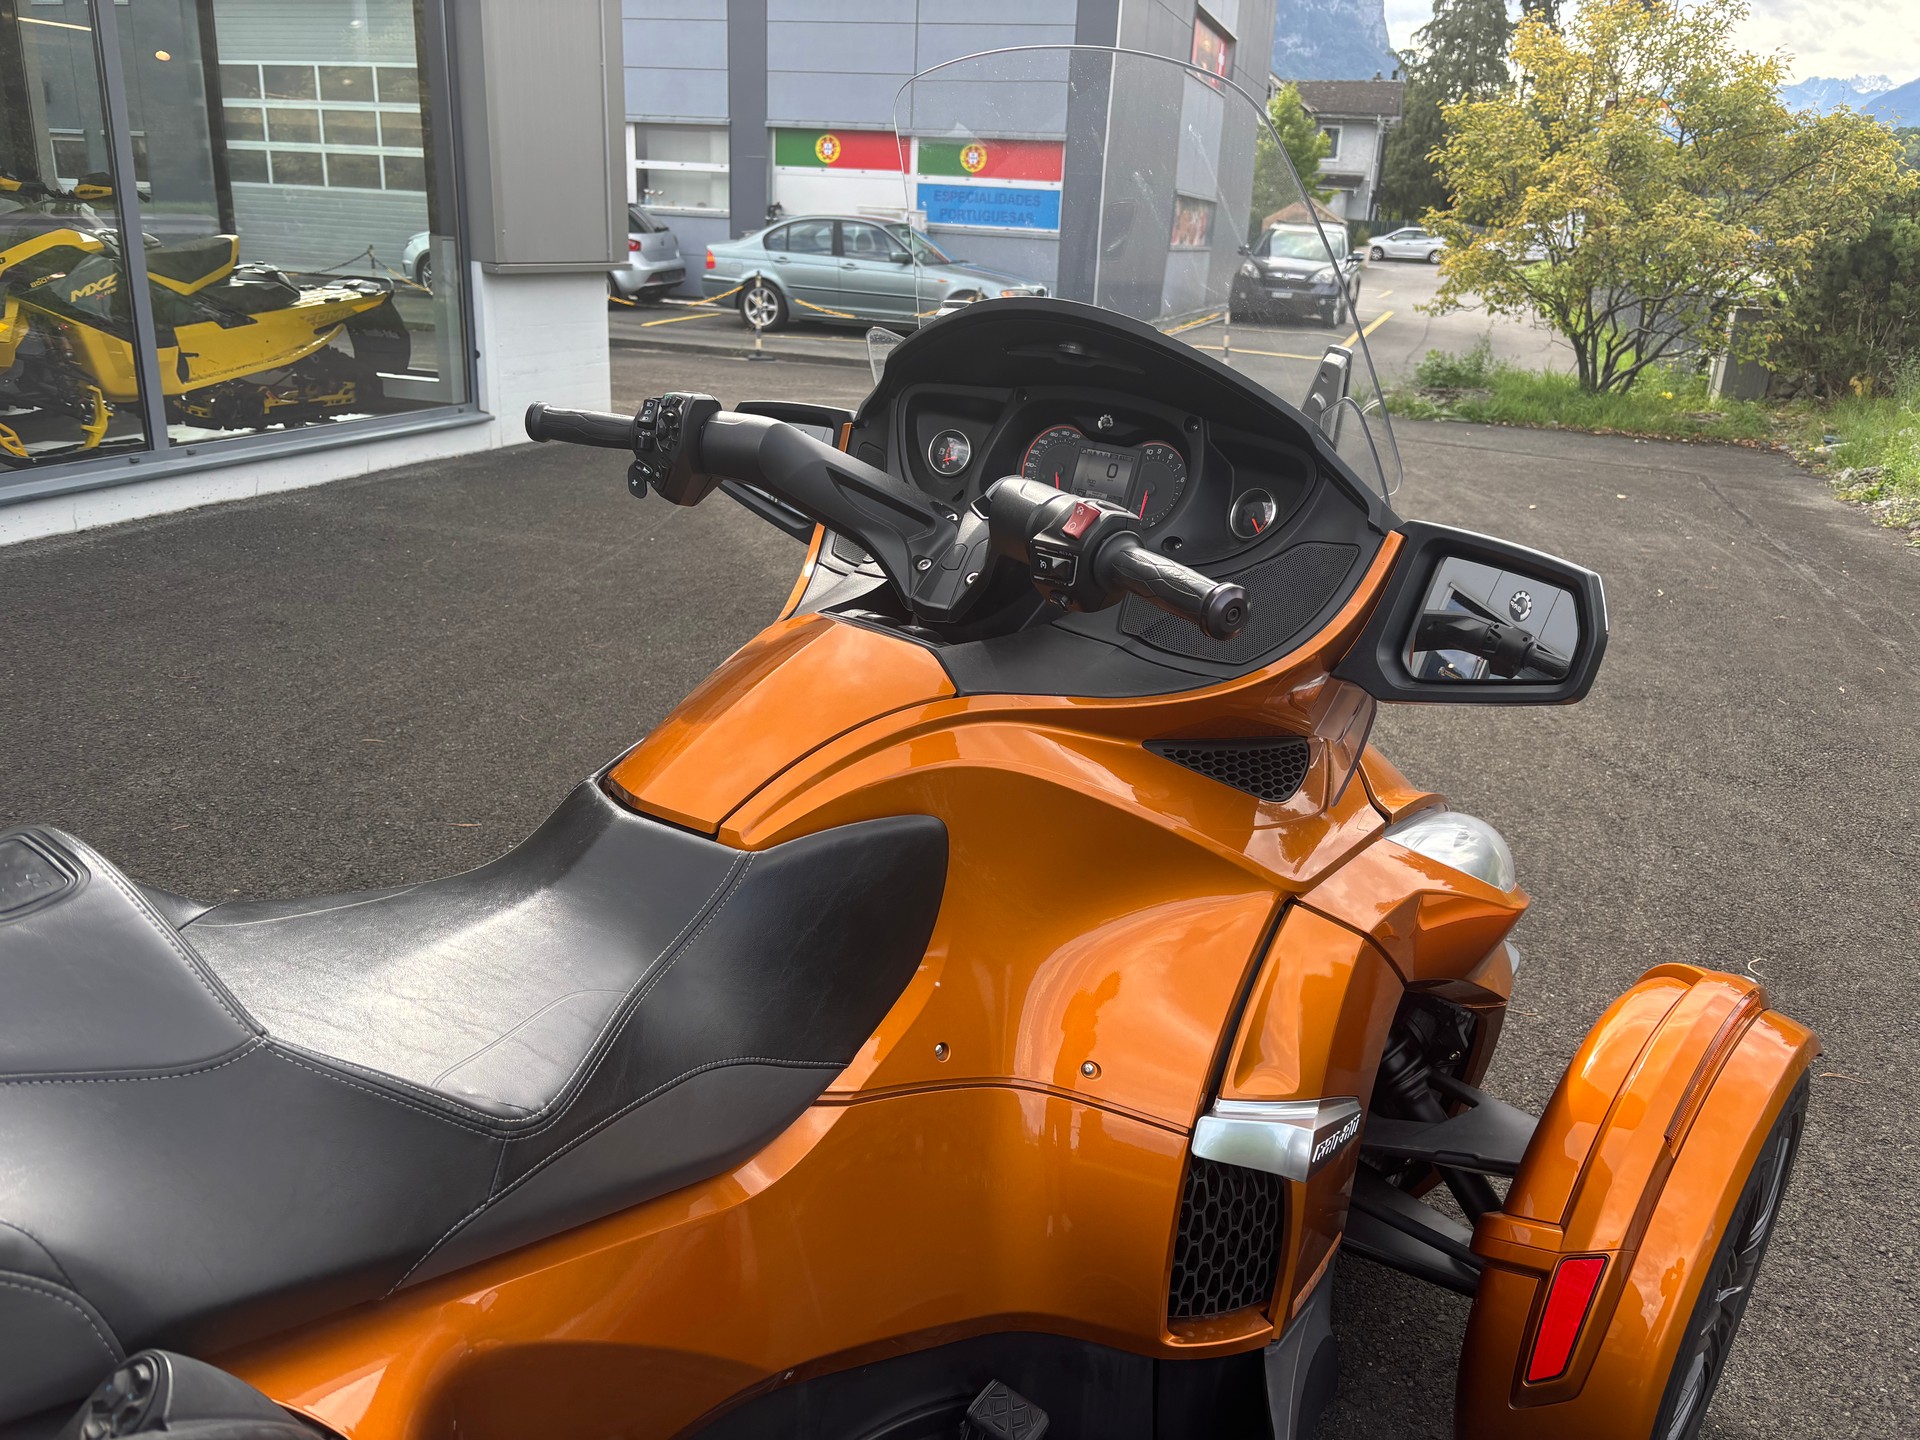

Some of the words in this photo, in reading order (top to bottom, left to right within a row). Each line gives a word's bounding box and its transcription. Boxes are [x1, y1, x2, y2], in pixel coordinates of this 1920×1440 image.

[933, 190, 1041, 207] ESPECIALIDADES
[939, 208, 1034, 224] PORTUGUESAS
[71, 273, 118, 303] MXZ
[1106, 463, 1118, 479] 0
